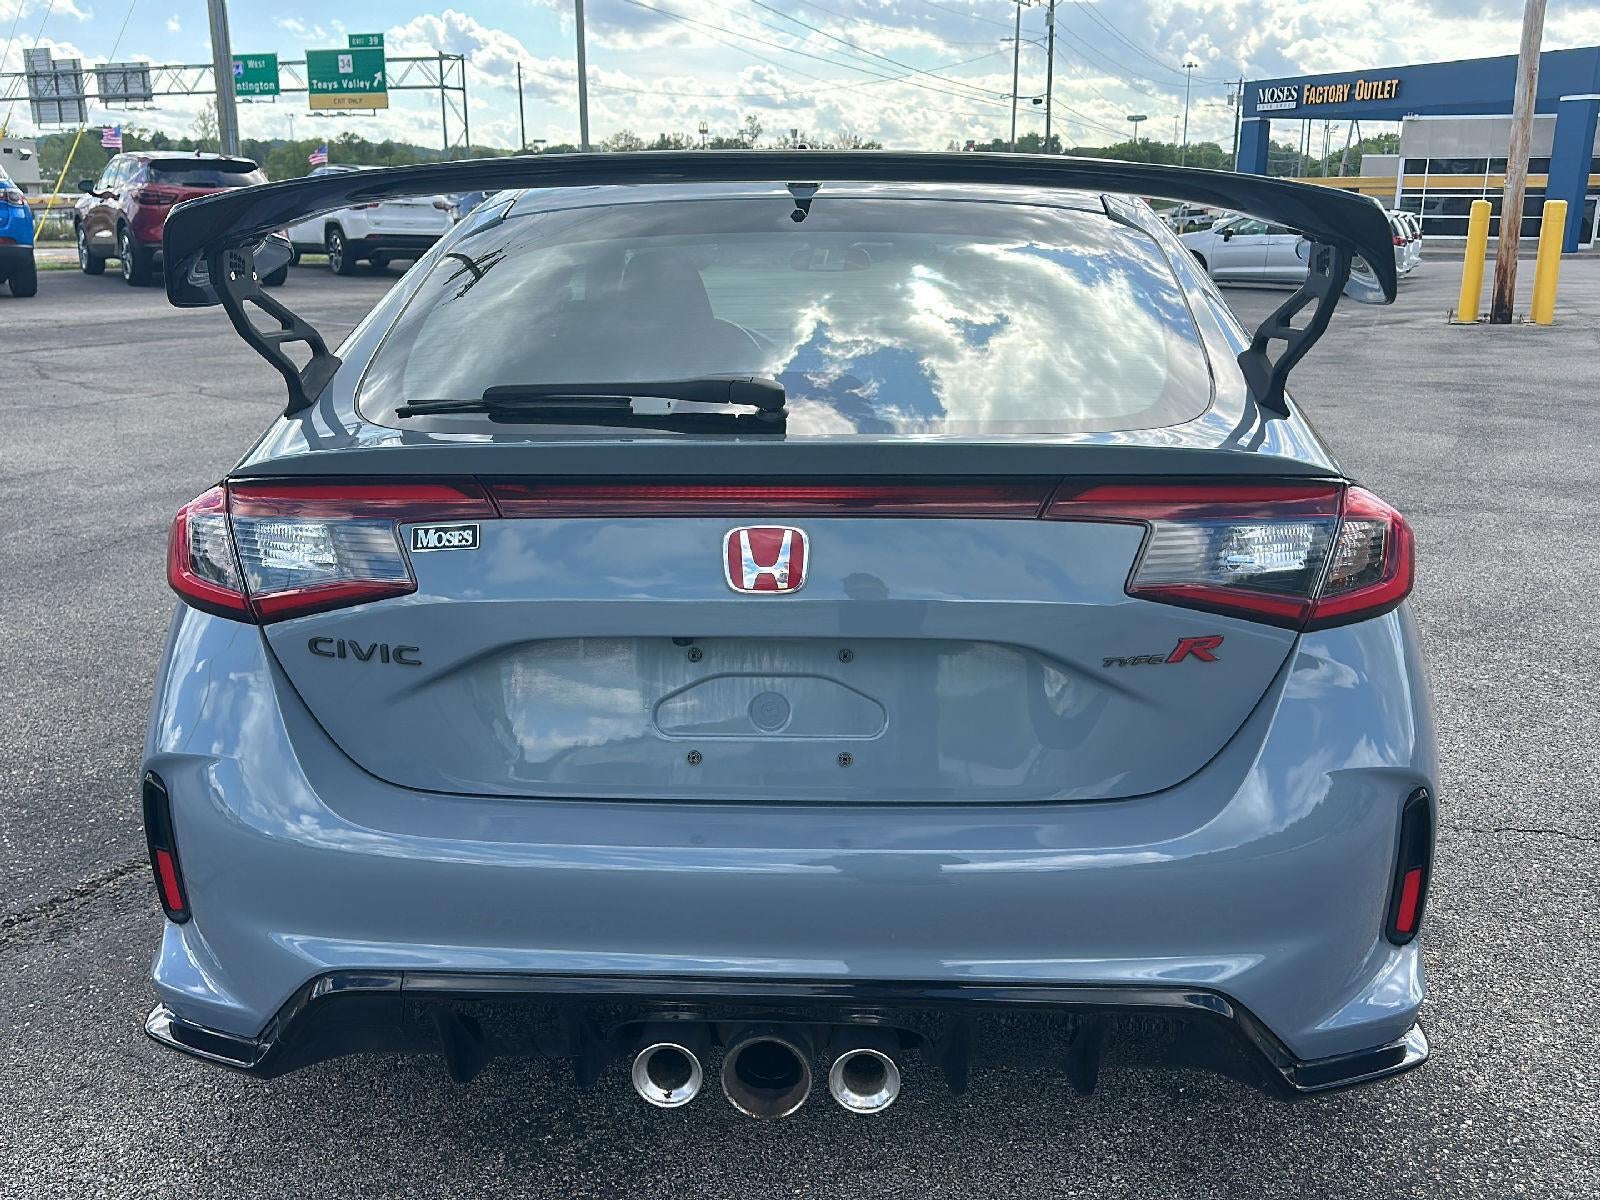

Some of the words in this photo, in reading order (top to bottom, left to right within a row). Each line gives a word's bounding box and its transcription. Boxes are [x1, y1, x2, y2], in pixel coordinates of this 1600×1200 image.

[368, 36, 379, 45] 39
[340, 58, 351, 69] 34
[236, 81, 275, 94] ntington
[312, 79, 339, 91] Teays
[342, 78, 371, 91] Valley
[1257, 85, 1299, 104] MOSES
[1302, 83, 1351, 105] FACTORY
[1354, 79, 1399, 101] OUTLET
[416, 529, 473, 548] MOSES
[307, 636, 422, 666] CIVIC
[1102, 653, 1166, 668] TYPE
[1164, 634, 1225, 665] R
